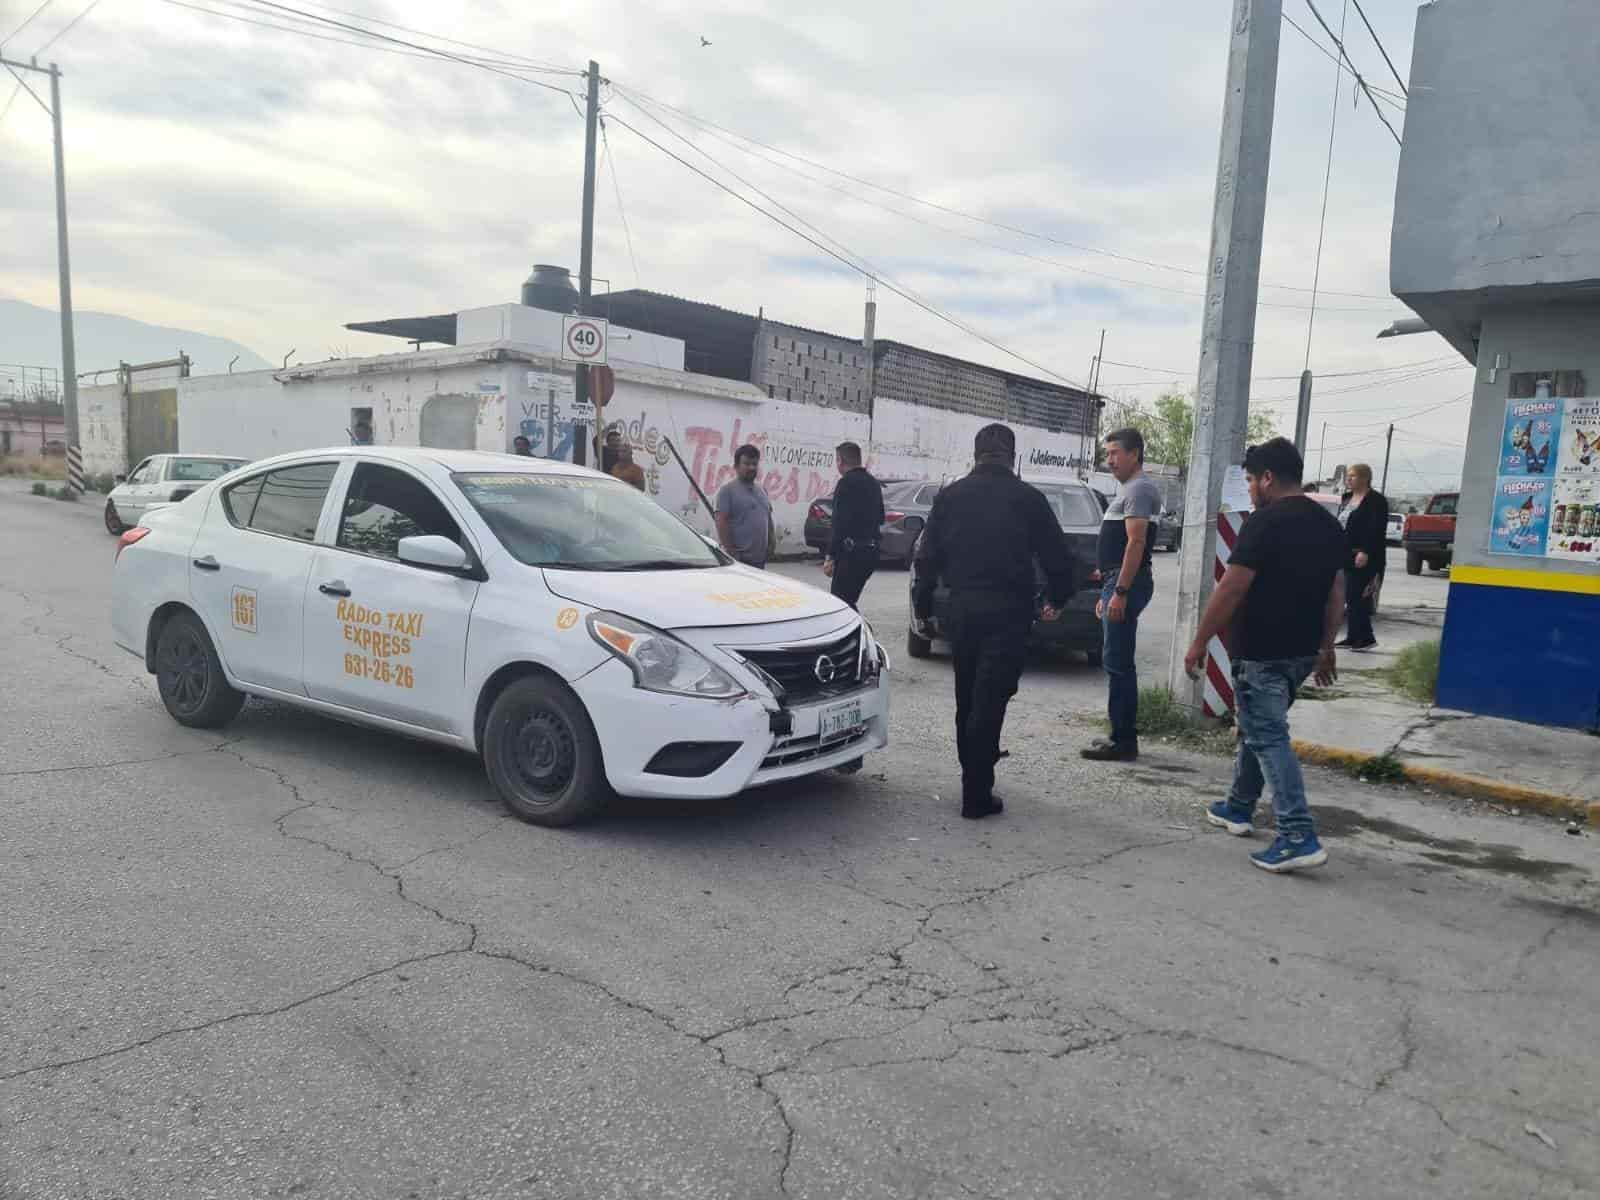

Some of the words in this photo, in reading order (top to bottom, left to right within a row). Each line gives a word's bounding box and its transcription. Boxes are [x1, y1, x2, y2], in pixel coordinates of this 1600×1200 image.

[574, 329, 595, 346] 40
[336, 598, 382, 625] RADIO
[386, 611, 423, 638] TAXI
[344, 623, 411, 658] EXPRESS
[344, 652, 414, 689] 631-26-26
